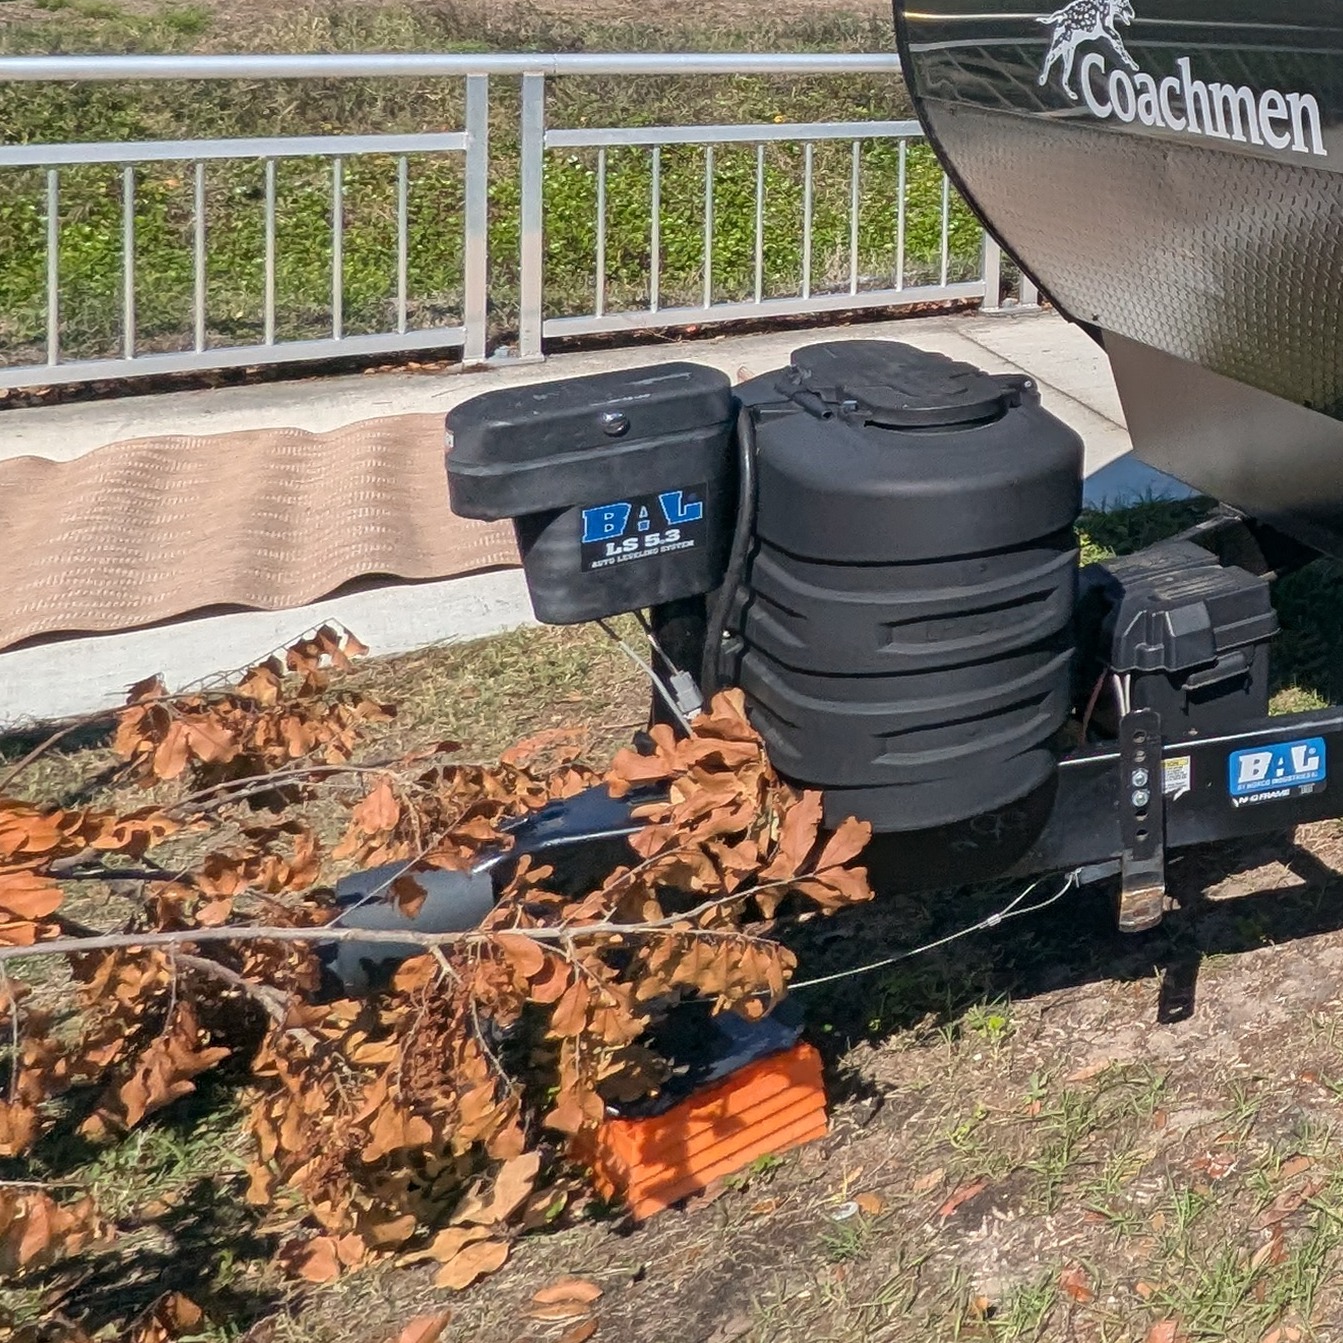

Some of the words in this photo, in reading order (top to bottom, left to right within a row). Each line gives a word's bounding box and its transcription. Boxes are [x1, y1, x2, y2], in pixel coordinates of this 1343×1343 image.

[1081, 52, 1328, 157] Coachmen
[591, 557, 615, 569] AUTO
[617, 547, 659, 563] LEVELING
[660, 539, 695, 553] SYSTEM
[605, 537, 639, 556] LS
[644, 528, 681, 547] 5.3
